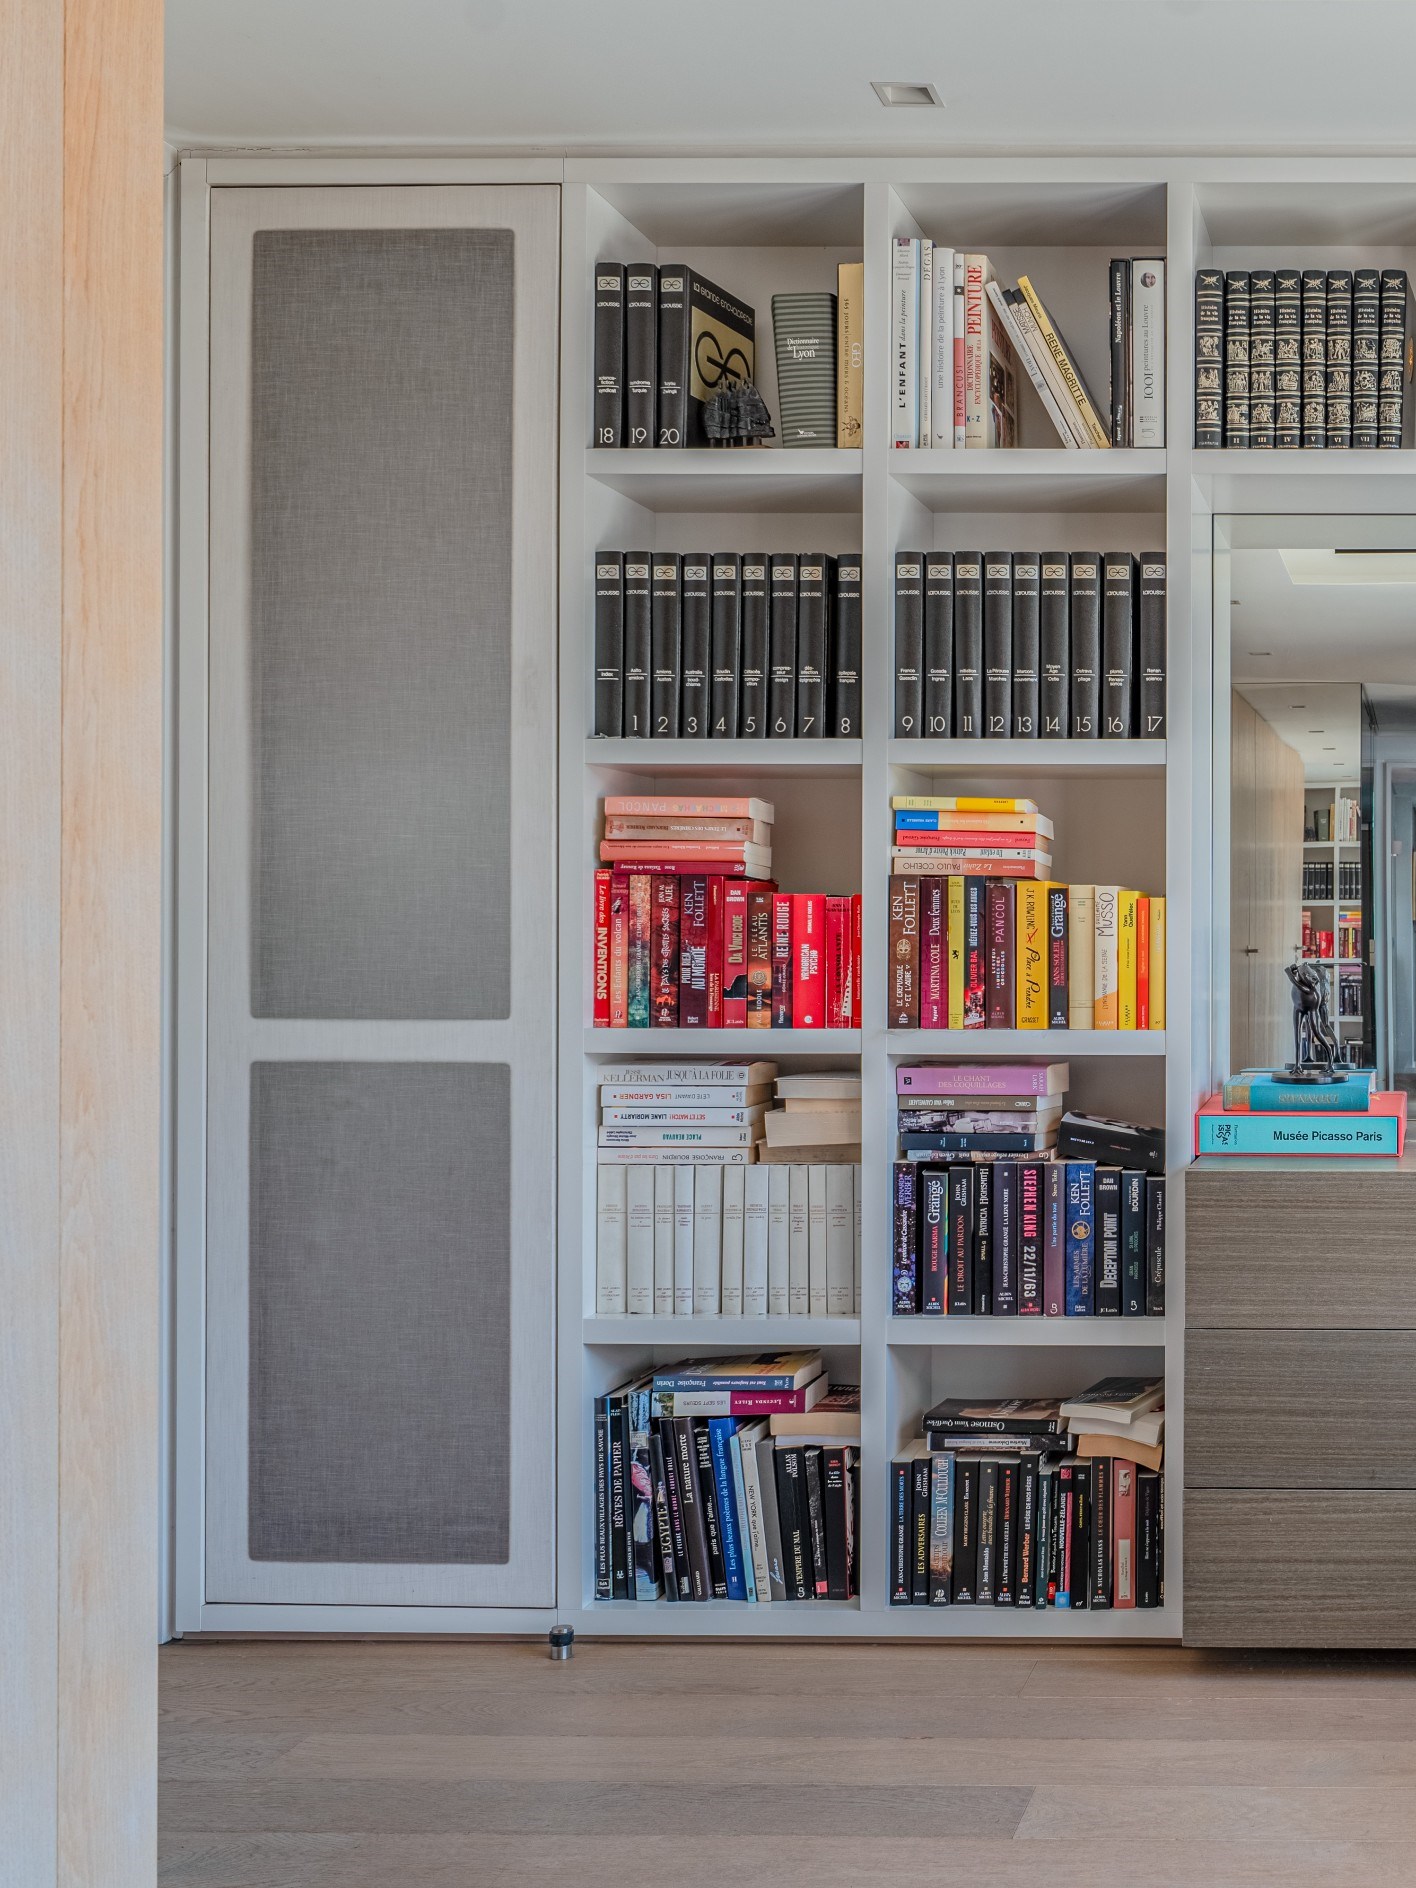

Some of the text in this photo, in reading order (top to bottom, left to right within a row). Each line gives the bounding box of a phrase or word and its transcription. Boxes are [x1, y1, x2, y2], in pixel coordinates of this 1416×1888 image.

[937, 266, 945, 284] Lyon
[899, 290, 908, 316] peinture
[937, 292, 945, 323] peinture
[967, 265, 982, 335] PEINTURE
[937, 334, 944, 343] de
[793, 346, 816, 360] Lyon
[851, 342, 861, 368] GEO
[600, 428, 614, 443] 18
[632, 428, 646, 443] 19
[660, 429, 679, 444] 20
[633, 716, 637, 730] 1
[658, 717, 668, 732] 2
[688, 717, 697, 732] 3
[716, 717, 726, 732] 4
[745, 717, 756, 732] 5
[775, 717, 786, 732] 6
[803, 717, 815, 732] 7
[841, 718, 850, 733] 8
[902, 716, 913, 732] 9
[930, 716, 945, 732] 10
[964, 716, 972, 732] 11
[990, 716, 1004, 732] 12
[1018, 717, 1032, 732] 13
[1046, 716, 1060, 732] 14
[1077, 716, 1091, 732] 15
[1108, 716, 1123, 732] 16
[1147, 716, 1163, 732] 17
[618, 802, 666, 811] PANCOL
[684, 893, 693, 914] KEN
[694, 880, 704, 926] FOLLETT
[893, 896, 903, 920] KEN
[903, 881, 916, 935] FOLLETT
[928, 889, 940, 935] Deux femmes
[995, 896, 1004, 942] PANCOL
[1051, 894, 1066, 937] Grangé
[758, 912, 767, 960] ATLANTIS
[777, 901, 789, 957] REINE ROUGE
[614, 946, 621, 956] du
[597, 927, 608, 999] INVENTIONS
[692, 946, 706, 989] AU MONDE
[930, 943, 940, 1000] MARTINA COLE
[603, 1073, 664, 1082] KELLERMAN
[1273, 1130, 1382, 1141] Musée Picasso Paris
[1071, 1183, 1080, 1204] KEN
[1080, 1171, 1090, 1215] FOLLETT
[928, 1180, 943, 1223] Grangé
[979, 1168, 988, 1236] PATRICIA HIGHSMITH
[1024, 1170, 1036, 1237] STEPHEN KING
[957, 1248, 964, 1258] AU
[1100, 1212, 1118, 1288] DECEPTION POINT
[1024, 1245, 1036, 1297] 22/11/63
[970, 1421, 1004, 1430] Osmose
[613, 1441, 624, 1527] RÊVES DE PAPIER
